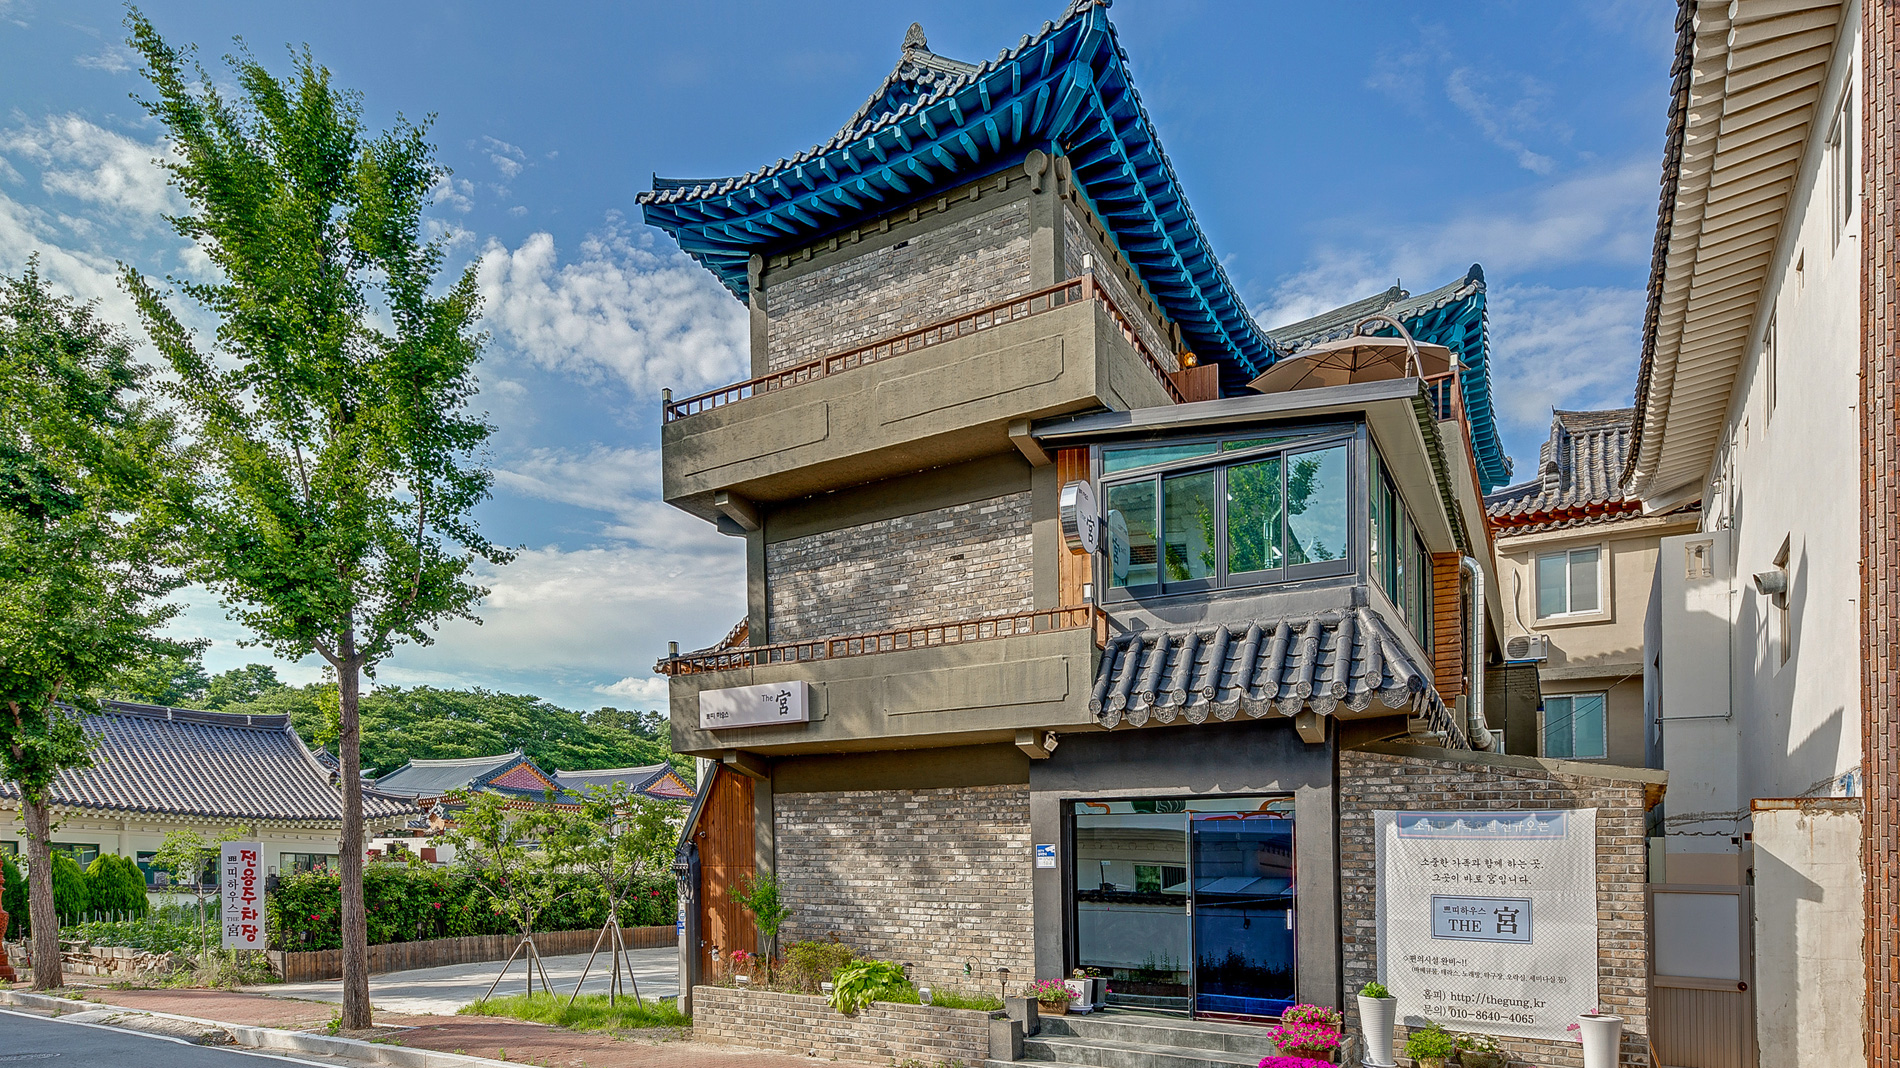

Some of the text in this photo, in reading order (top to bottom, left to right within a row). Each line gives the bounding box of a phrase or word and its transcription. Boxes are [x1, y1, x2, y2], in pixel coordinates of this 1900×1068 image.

[1086, 514, 1095, 545] 宮
[761, 689, 792, 716] The 宮
[1413, 819, 1550, 833] 소규모 가족호텔 신규오픈
[1420, 857, 1544, 870] 소중한 가족과 함께 하는 곳.
[226, 855, 239, 913] 쁘띠하우스
[1432, 873, 1459, 884] 그곳이
[1464, 873, 1483, 884] 바로
[240, 849, 259, 942] 전용주차장
[1443, 905, 1487, 915] 쁘띠하우스
[1448, 919, 1482, 933] THE
[1493, 906, 1520, 935] 宮
[226, 923, 240, 937] 宮
[1450, 991, 1547, 1009] http://thegung.kr
[1423, 1004, 1534, 1024] 문의) 010-8640-4065
